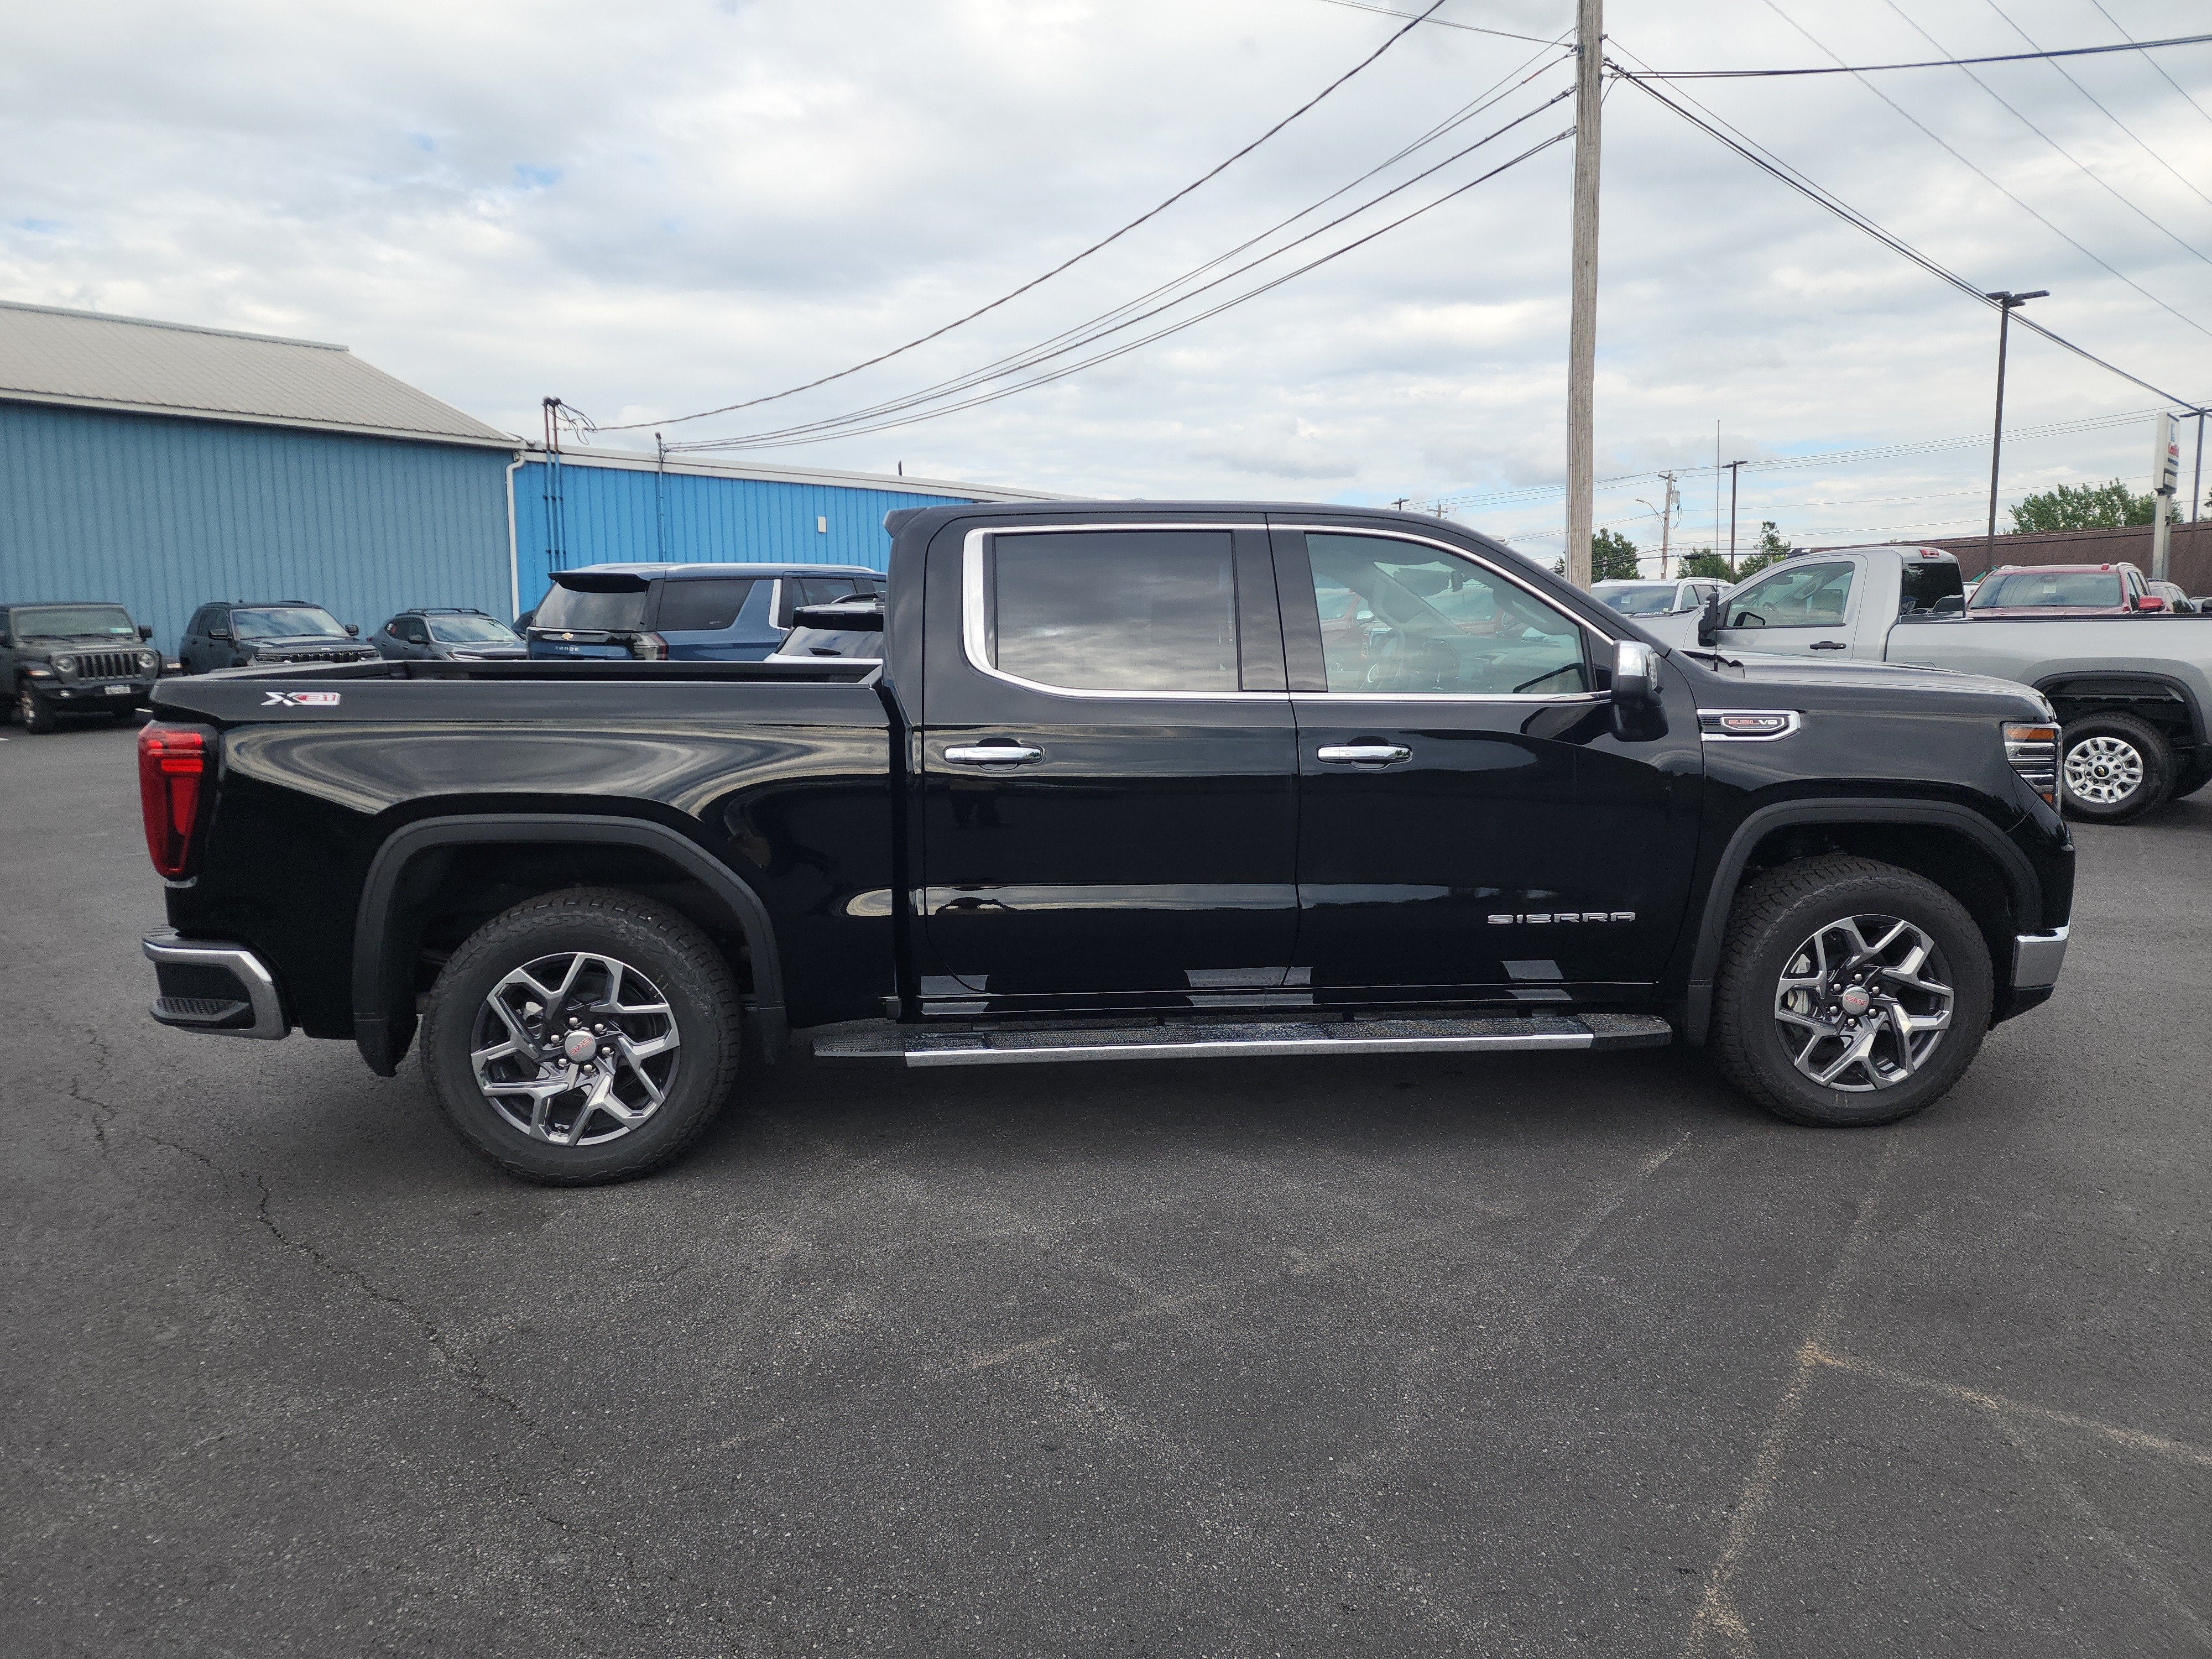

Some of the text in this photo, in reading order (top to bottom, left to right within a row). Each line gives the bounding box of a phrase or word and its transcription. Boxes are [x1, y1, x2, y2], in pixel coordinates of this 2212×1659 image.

[1487, 911, 1636, 924] SIERRA
[1845, 995, 1868, 1006] GMC
[568, 1037, 592, 1056] GMC
